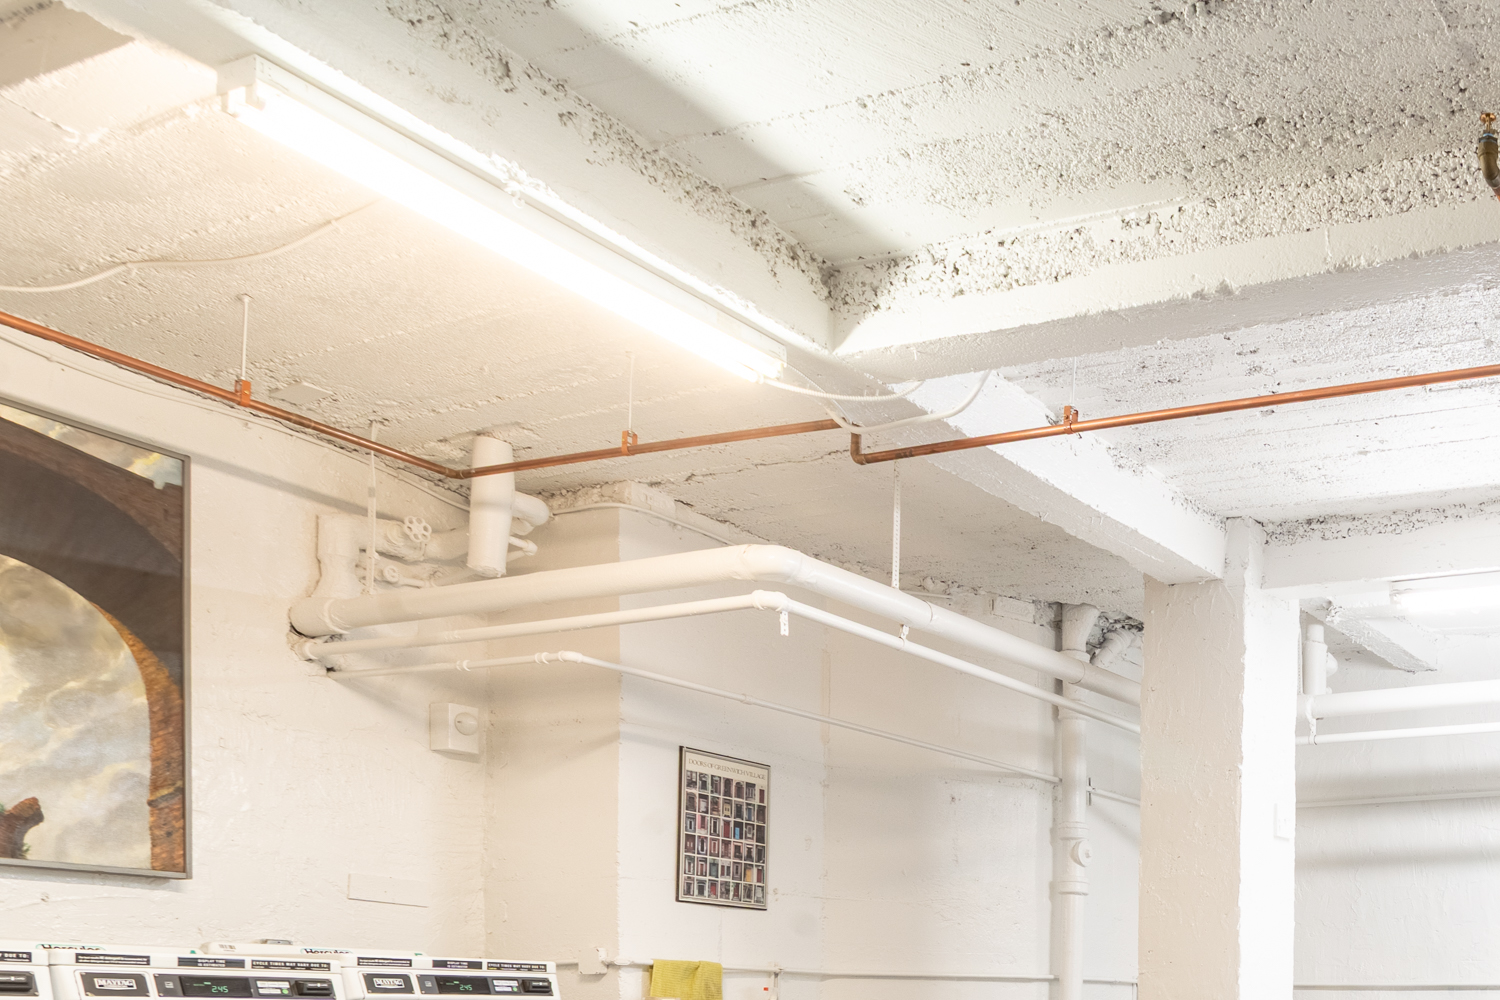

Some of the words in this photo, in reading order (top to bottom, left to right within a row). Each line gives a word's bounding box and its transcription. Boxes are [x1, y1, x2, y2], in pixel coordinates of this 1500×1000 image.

[688, 758, 706, 767] DOORS
[714, 764, 745, 775] GREENWICH
[746, 770, 765, 780] VILLAGE
